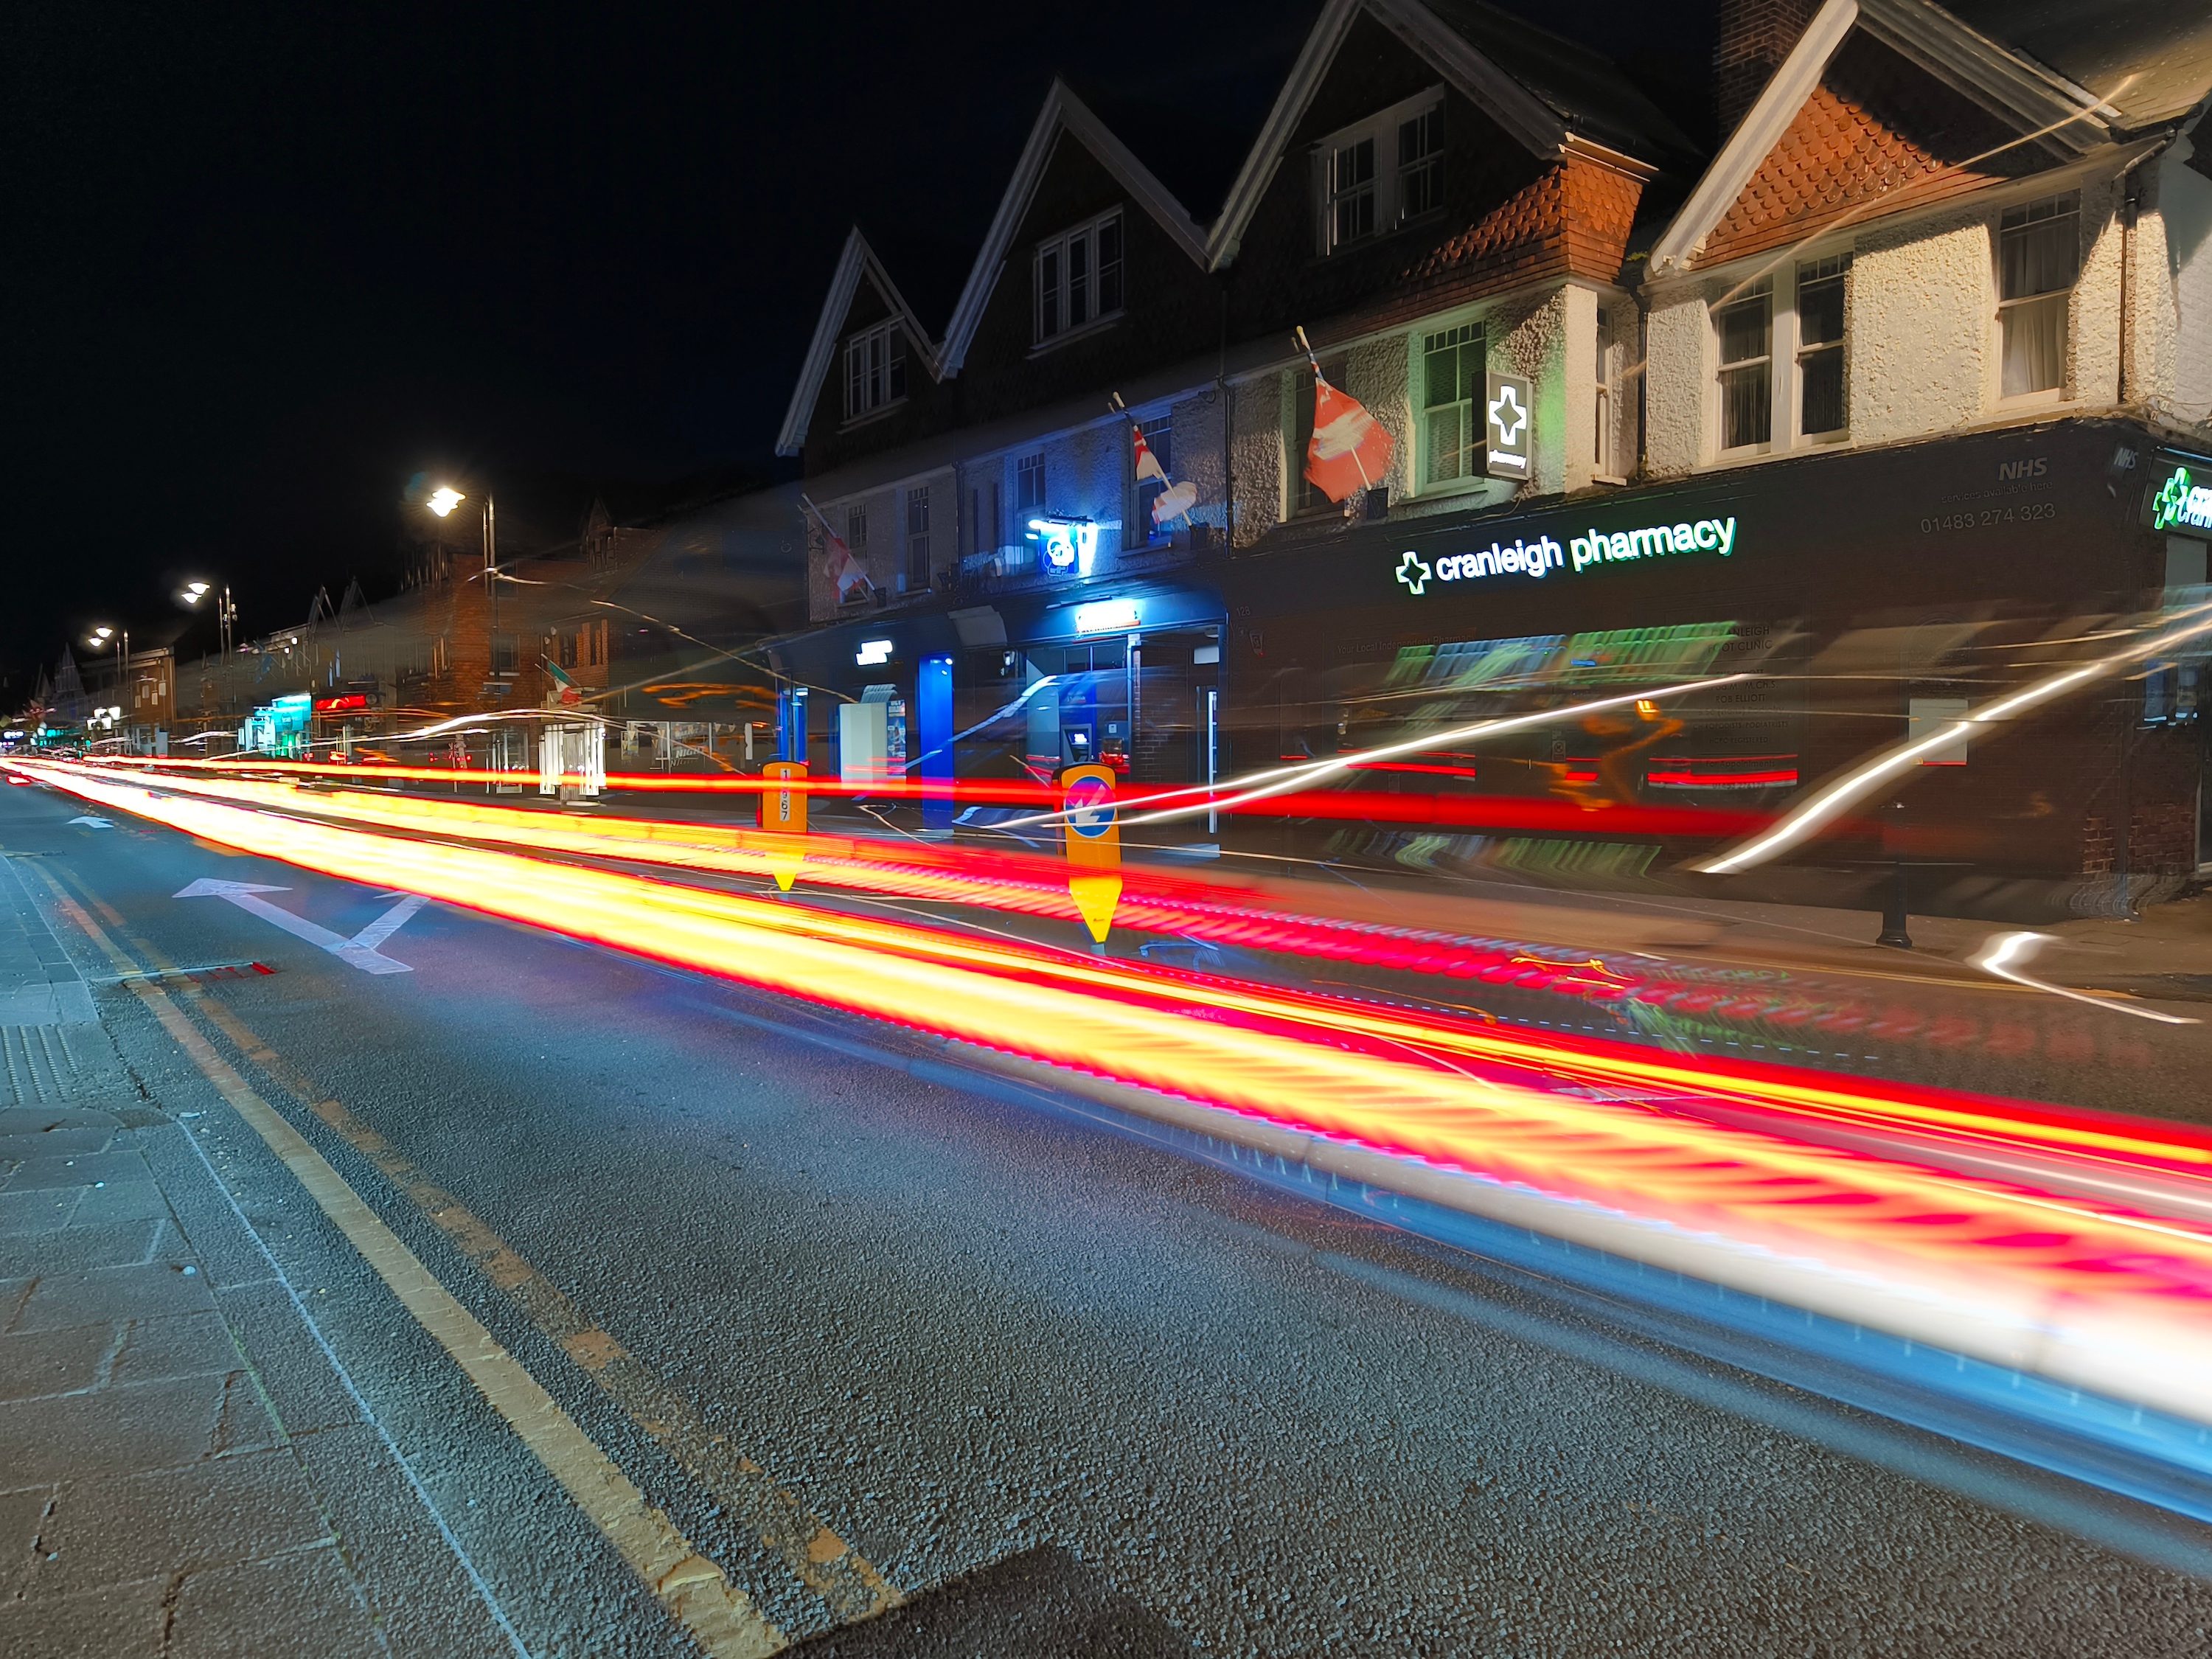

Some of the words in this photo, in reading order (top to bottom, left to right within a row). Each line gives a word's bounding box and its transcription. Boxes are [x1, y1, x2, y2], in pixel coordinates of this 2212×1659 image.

[1999, 457, 2048, 481] NHS
[2113, 447, 2139, 469] NHS
[1941, 490, 1982, 504] services
[1983, 484, 2028, 499] available
[2029, 481, 2053, 492] here
[1920, 512, 1976, 534] 01483
[1980, 507, 2015, 526] 274
[2020, 502, 2056, 522] 323
[1436, 535, 1564, 577] cranleigh
[1570, 517, 1736, 572] pharmacy
[1236, 605, 1251, 617] 128
[1338, 644, 1354, 655] Your
[1356, 641, 1377, 653] Local
[1738, 639, 1773, 650] CLINIC
